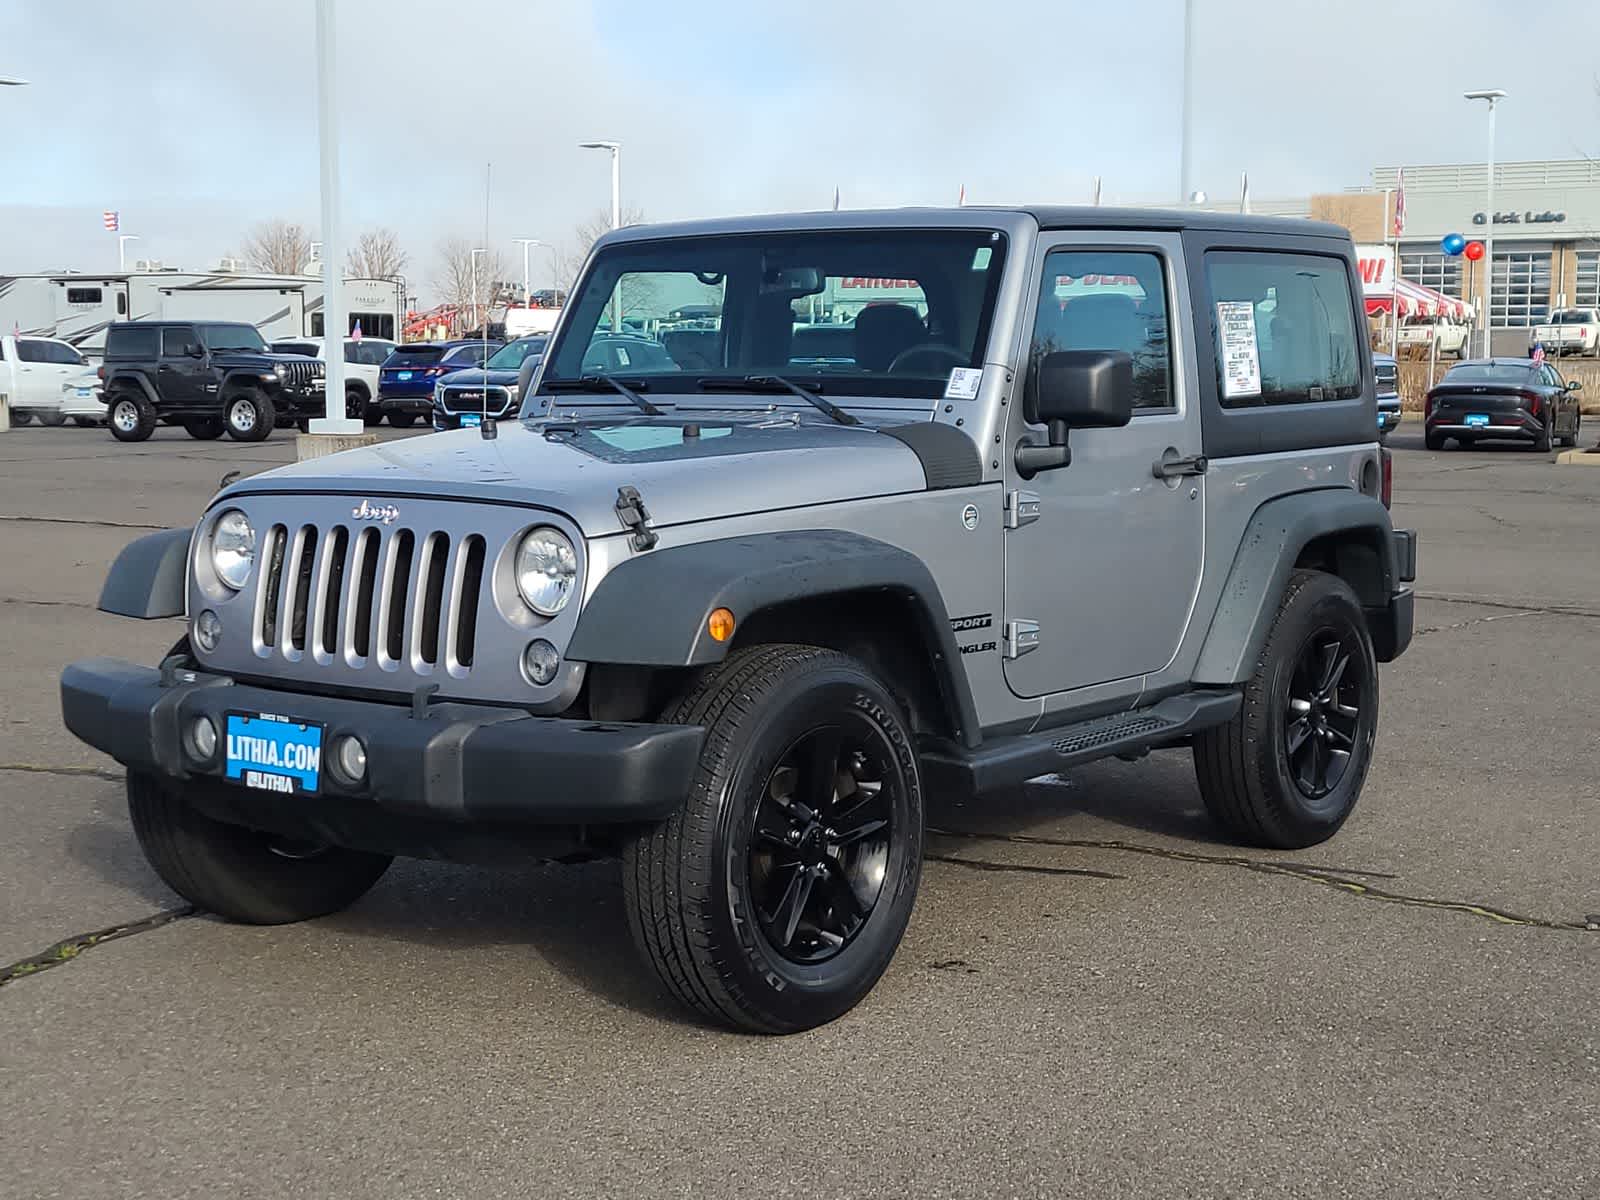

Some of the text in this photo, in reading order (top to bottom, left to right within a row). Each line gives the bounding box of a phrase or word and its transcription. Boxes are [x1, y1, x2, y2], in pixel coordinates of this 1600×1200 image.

[1472, 210, 1566, 225] Qick Lube
[351, 499, 399, 525] Jeep
[951, 617, 988, 630] PORT
[959, 641, 996, 654] NGLER
[227, 734, 320, 773] LITHIA.COM
[256, 771, 294, 794] LITHIA
